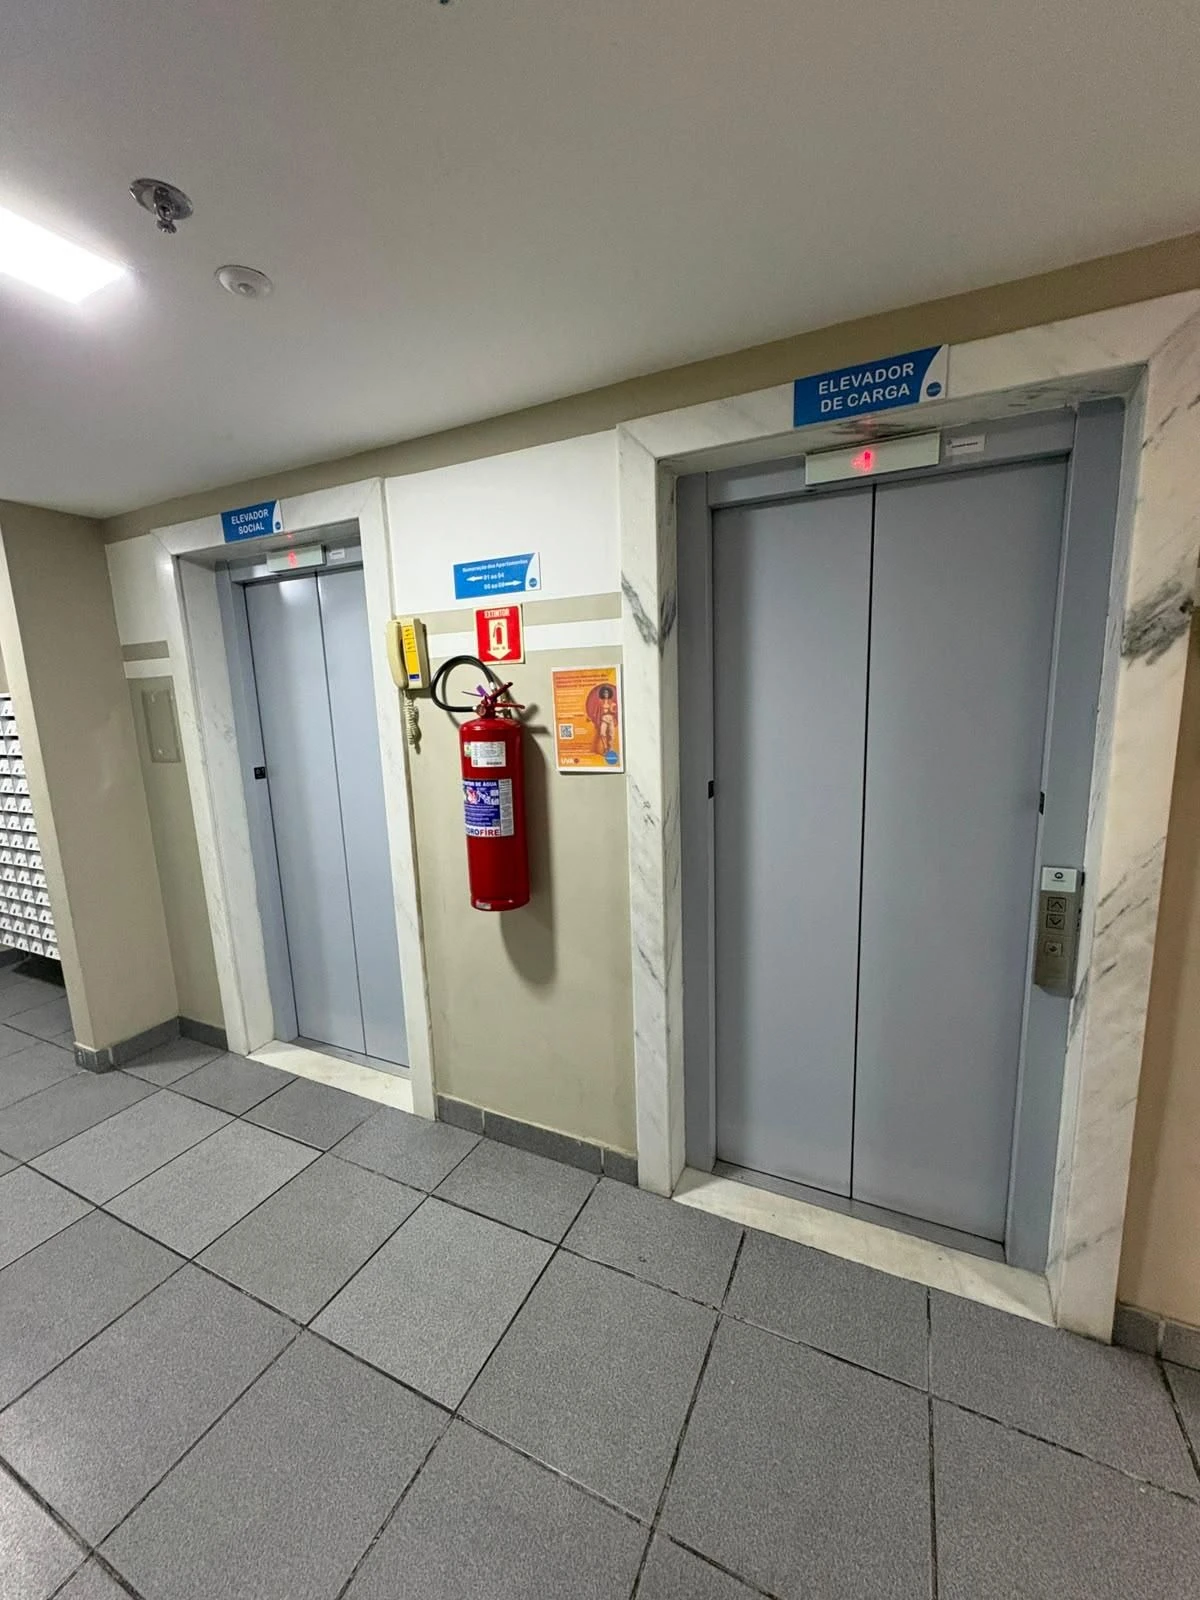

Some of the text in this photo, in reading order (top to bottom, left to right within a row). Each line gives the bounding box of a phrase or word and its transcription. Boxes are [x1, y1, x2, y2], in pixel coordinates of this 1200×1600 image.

[818, 362, 915, 395] ELEVADOR
[821, 399, 843, 413] DE
[847, 383, 911, 408] CARGA
[231, 508, 270, 525] ELEVADOR
[238, 521, 265, 535] SOCIAL
